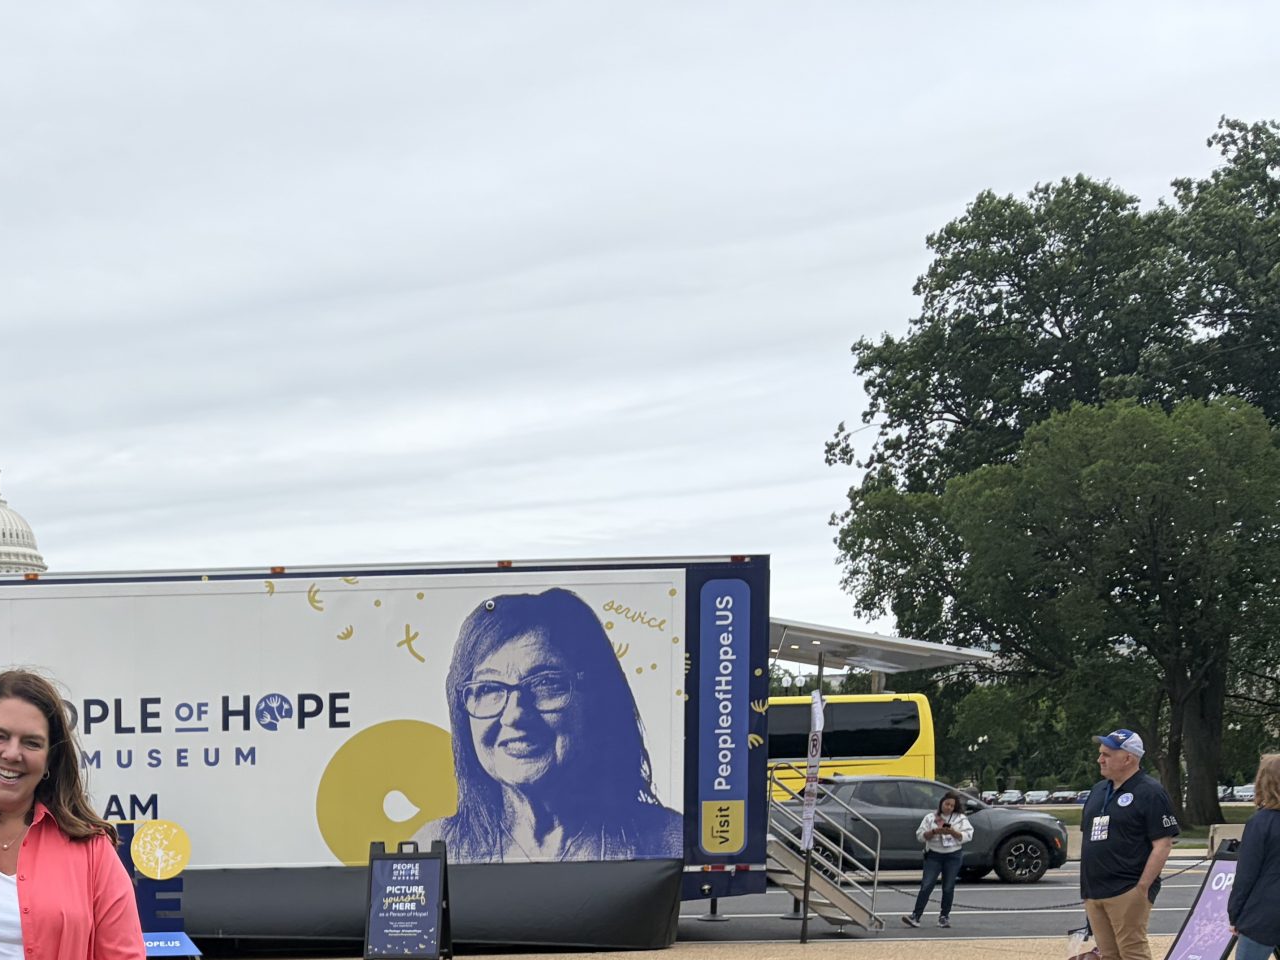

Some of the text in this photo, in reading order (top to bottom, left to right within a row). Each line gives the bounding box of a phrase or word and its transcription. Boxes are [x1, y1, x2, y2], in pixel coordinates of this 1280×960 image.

[603, 600, 666, 631] service
[714, 595, 736, 791] PeopleofHope.US
[175, 702, 209, 721] OF
[221, 692, 351, 731] HOPE
[81, 746, 256, 769] MUSEUM
[103, 793, 158, 820] AM
[713, 806, 730, 845] visit
[383, 890, 426, 910] yourself
[386, 885, 424, 893] PICTURE
[392, 902, 416, 911] HERE
